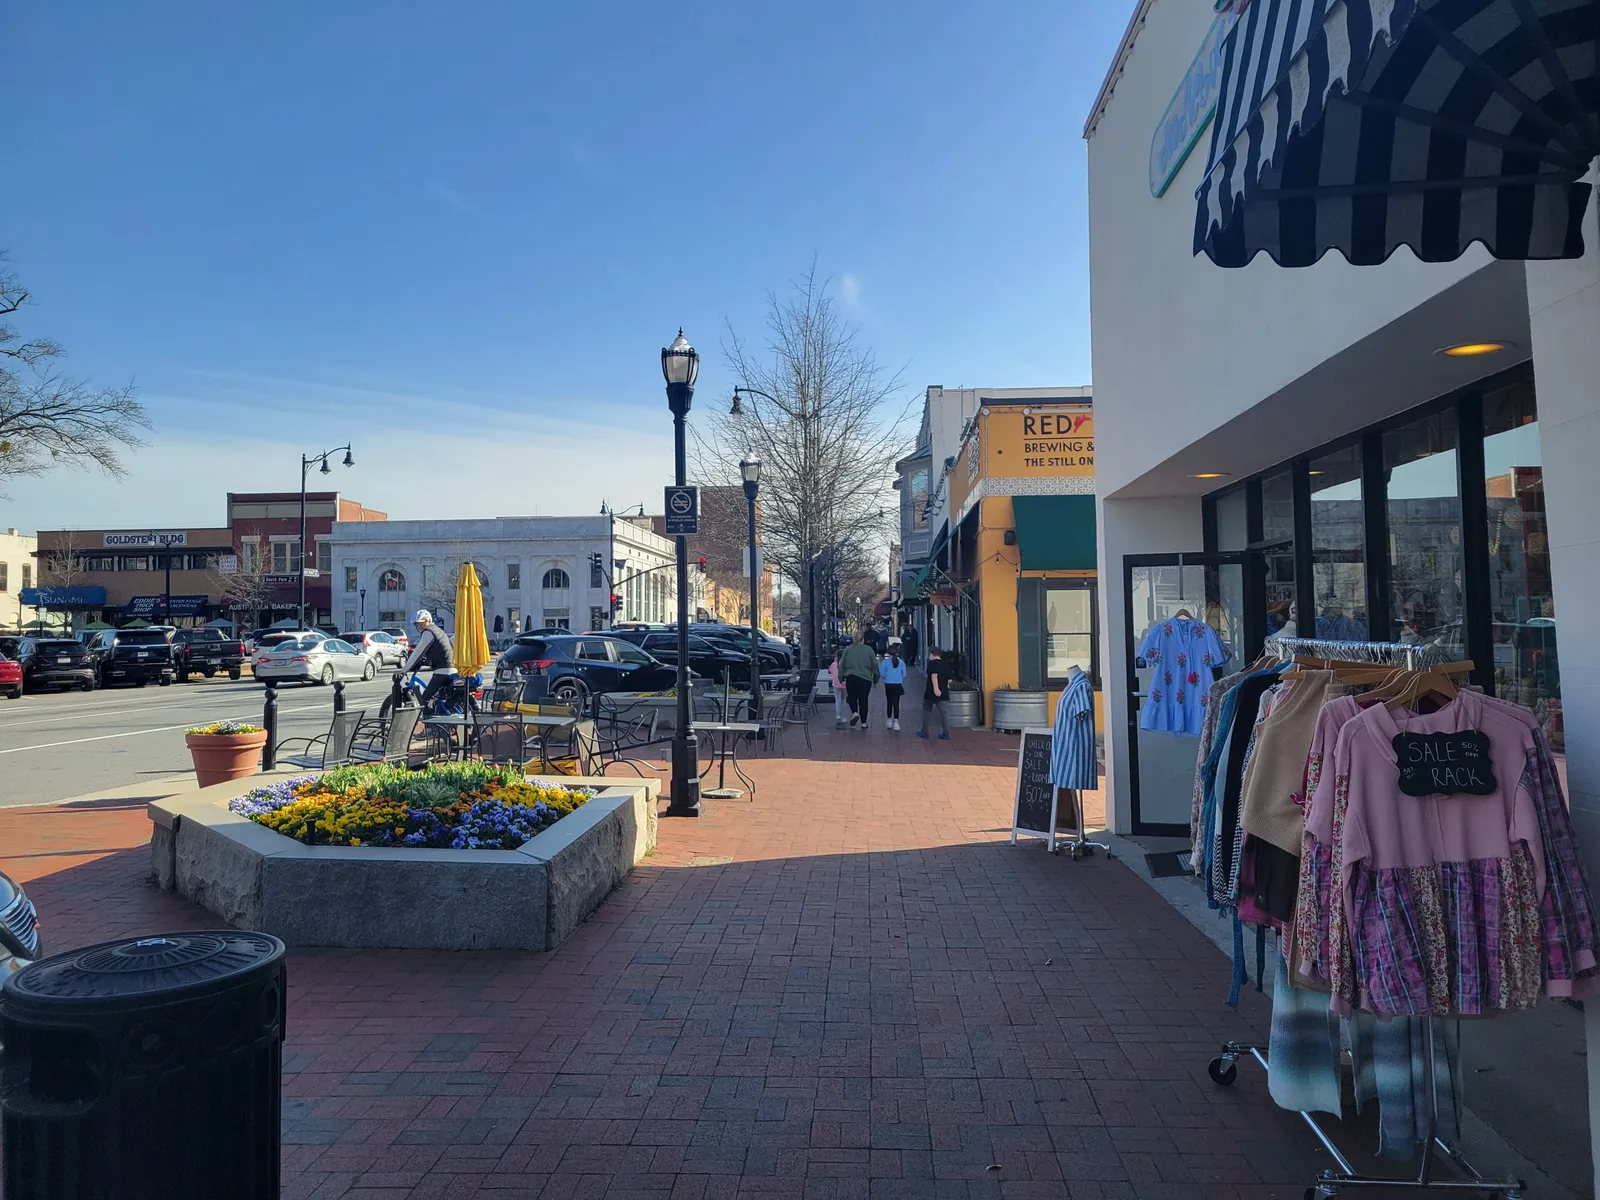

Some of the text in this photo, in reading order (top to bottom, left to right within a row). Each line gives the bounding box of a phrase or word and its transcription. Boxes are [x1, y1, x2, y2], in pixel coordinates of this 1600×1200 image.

[1023, 414, 1072, 435] RED
[1024, 441, 1095, 453] BREWING &
[1024, 457, 1045, 467] THE
[1047, 456, 1076, 467] STILL
[106, 535, 156, 545] GOLDSTEN
[1027, 740, 1045, 749] CHECK
[1408, 741, 1479, 762] SALE 50%
[1024, 758, 1041, 770] SALE
[1431, 766, 1485, 787] RACK
[1025, 784, 1043, 803] 50%
